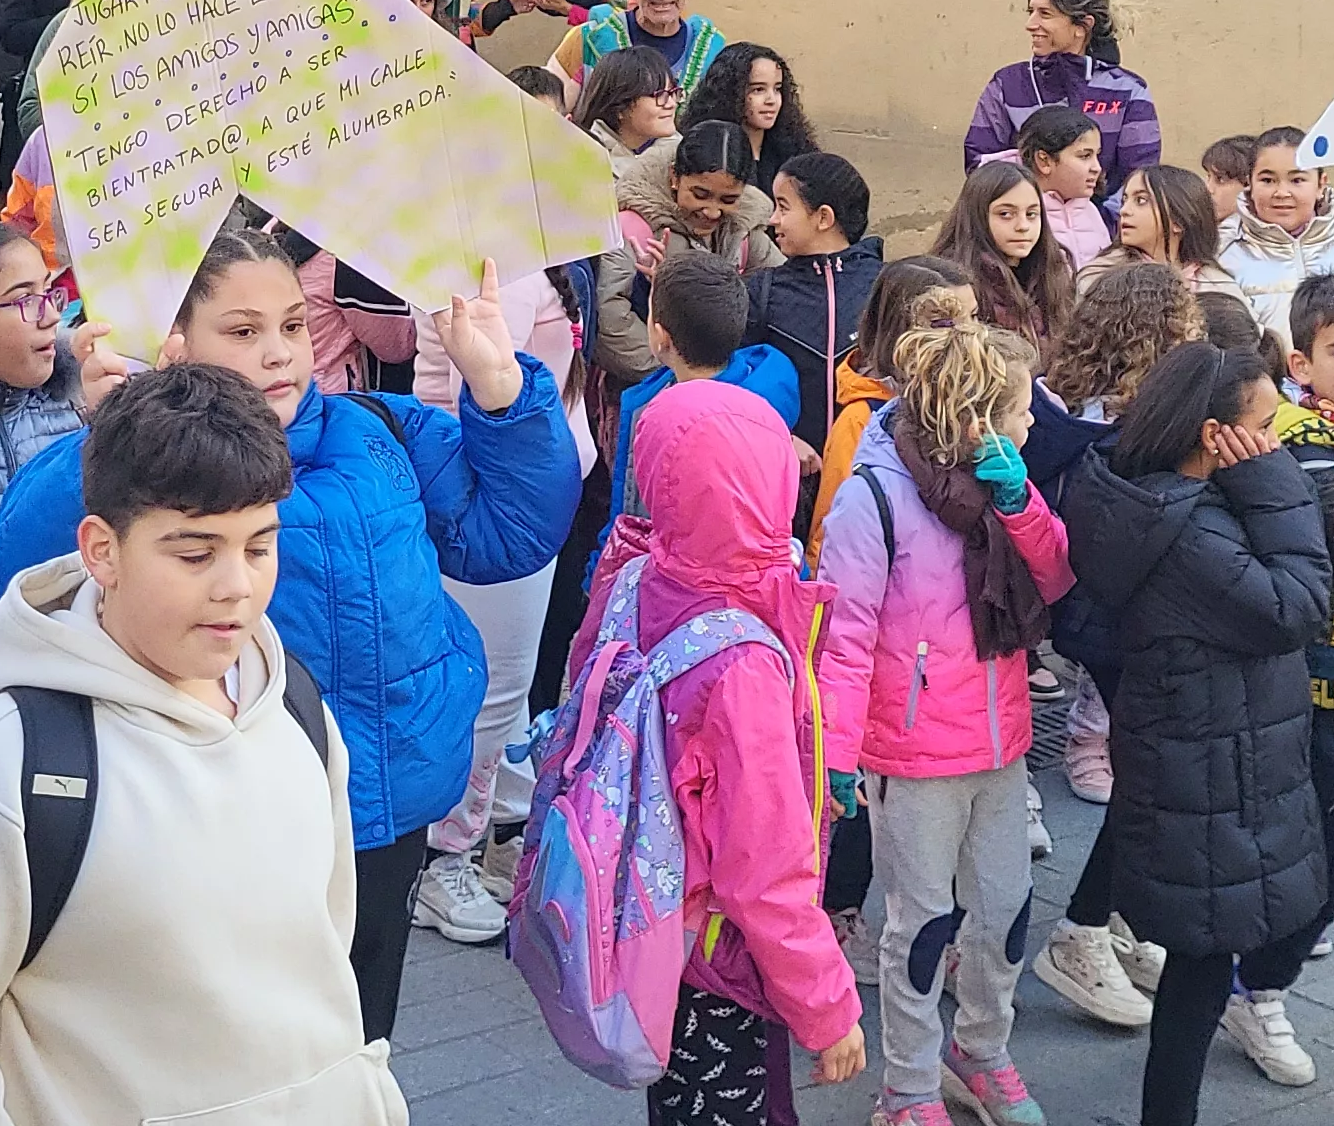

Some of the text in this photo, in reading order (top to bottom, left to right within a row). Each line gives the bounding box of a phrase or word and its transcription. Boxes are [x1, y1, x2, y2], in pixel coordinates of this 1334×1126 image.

[123, 20, 151, 51] NO
[156, 11, 177, 37] LO
[72, 72, 98, 115] SÍ
[110, 64, 150, 99] LOS
[165, 74, 267, 134] DERECHO
[279, 65, 293, 85] A
[308, 45, 348, 72] SER
[261, 116, 273, 136] A
[286, 92, 327, 125] QUE
[338, 74, 360, 101] MI
[370, 48, 427, 88] CALLE
[1082, 100, 1123, 115] FOX
[87, 218, 128, 251] SEA
[143, 176, 224, 227] SEGURA
[239, 163, 252, 184] Y
[267, 132, 312, 173] ESTÉ
